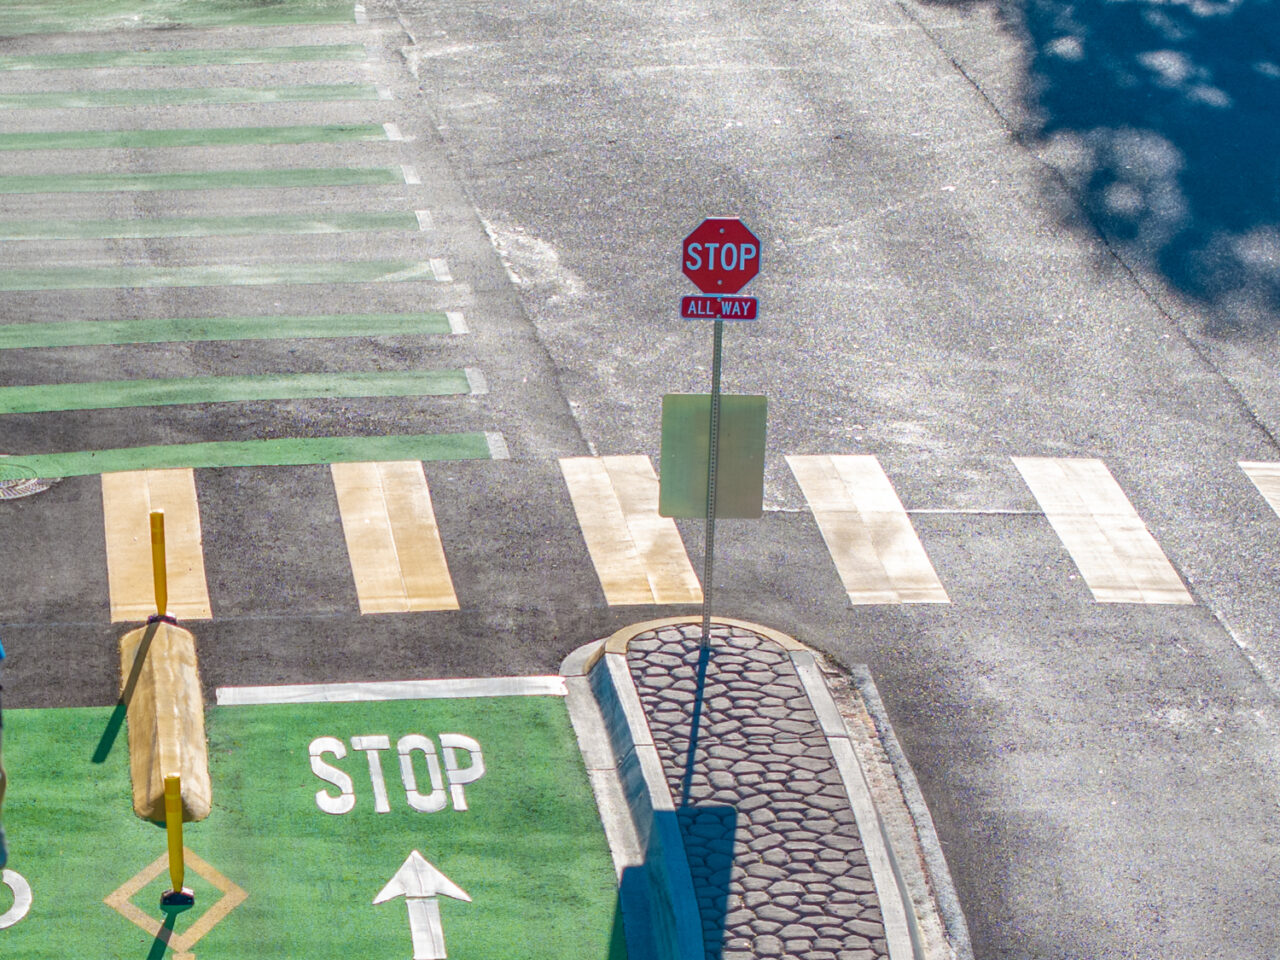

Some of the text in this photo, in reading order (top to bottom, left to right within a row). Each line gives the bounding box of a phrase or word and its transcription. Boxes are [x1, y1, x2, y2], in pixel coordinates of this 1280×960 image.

[685, 242, 757, 271] STOP
[687, 300, 751, 316] ALL WAY
[308, 732, 487, 815] STOP
